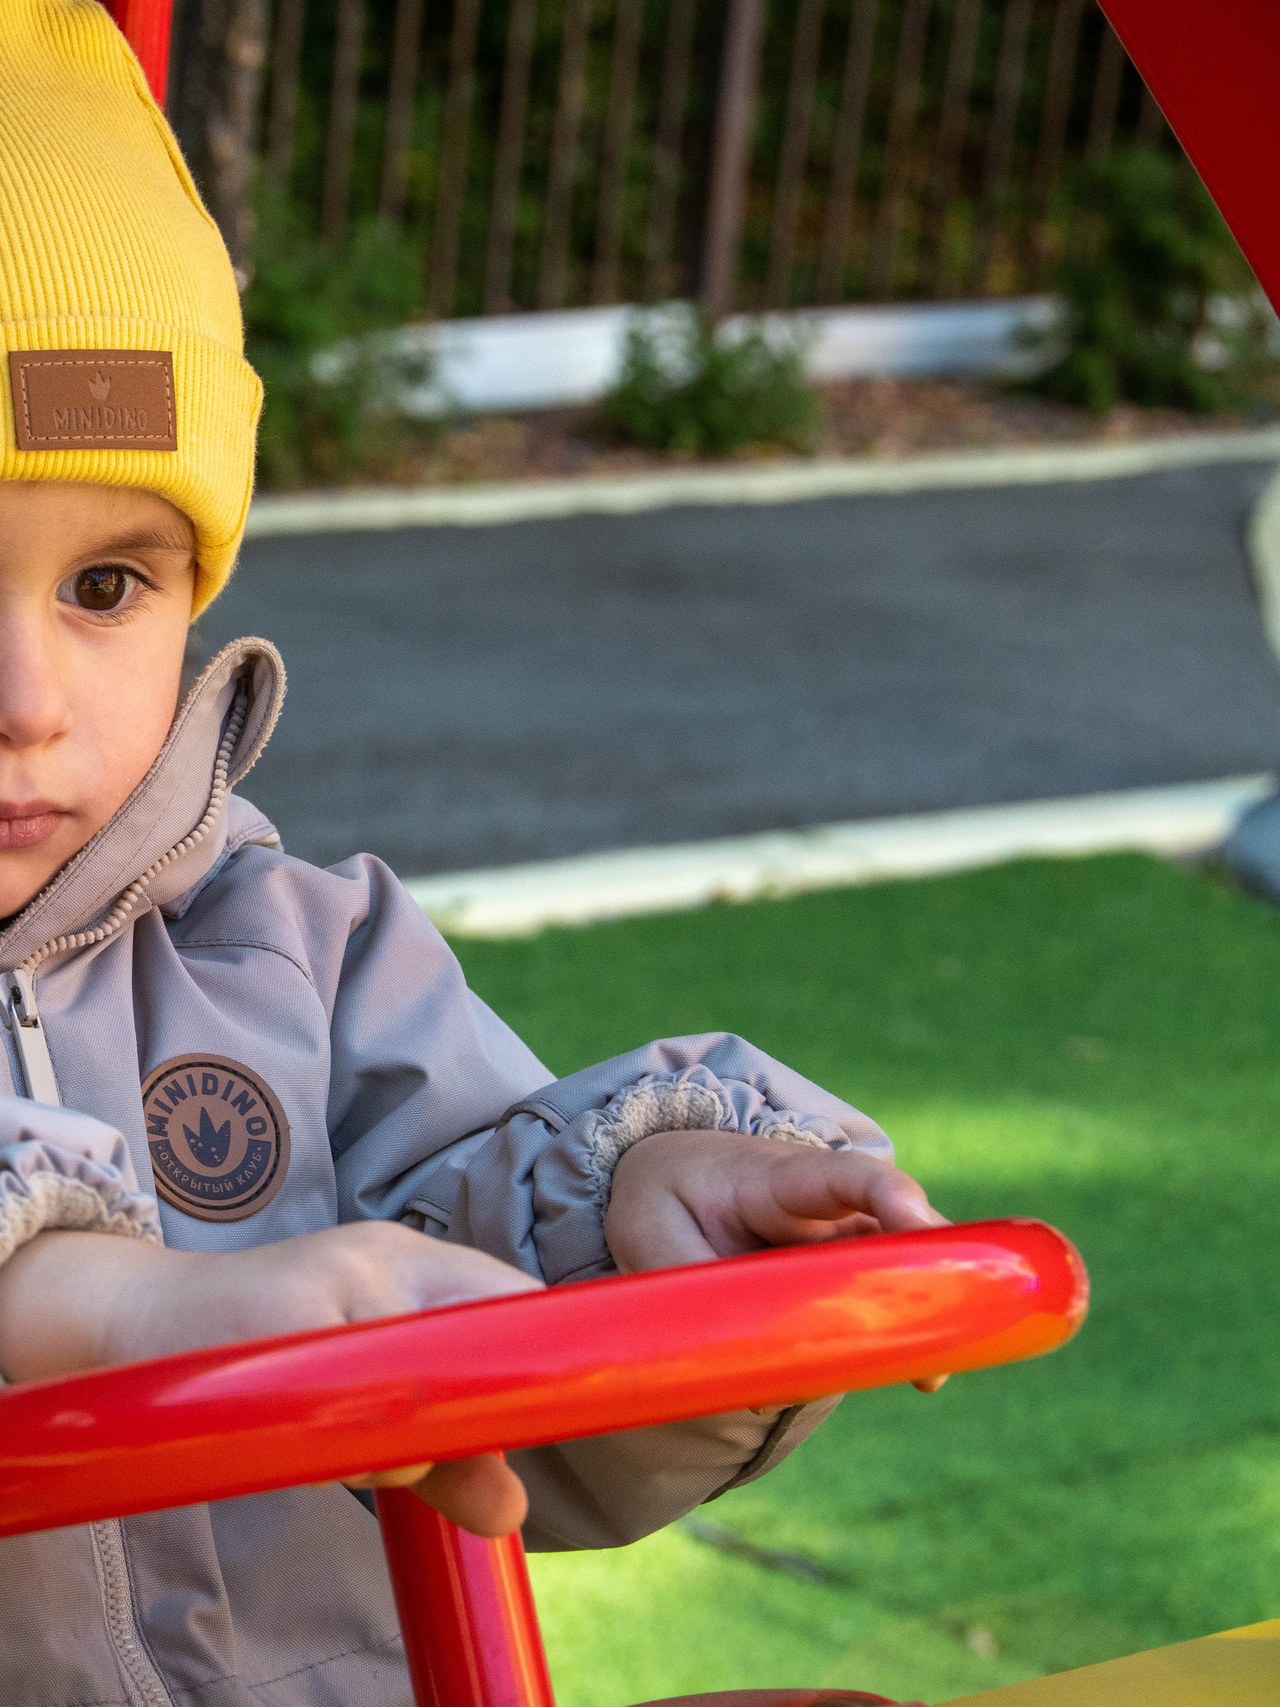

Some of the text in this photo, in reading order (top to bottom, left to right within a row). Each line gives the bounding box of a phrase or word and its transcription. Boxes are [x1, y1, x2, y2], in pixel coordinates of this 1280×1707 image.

[53, 406, 149, 430] MINIDINO
[147, 1072, 268, 1137] MINIDINO
[159, 1152, 262, 1194] ОТКРЫТЫЙ КЛУБ
